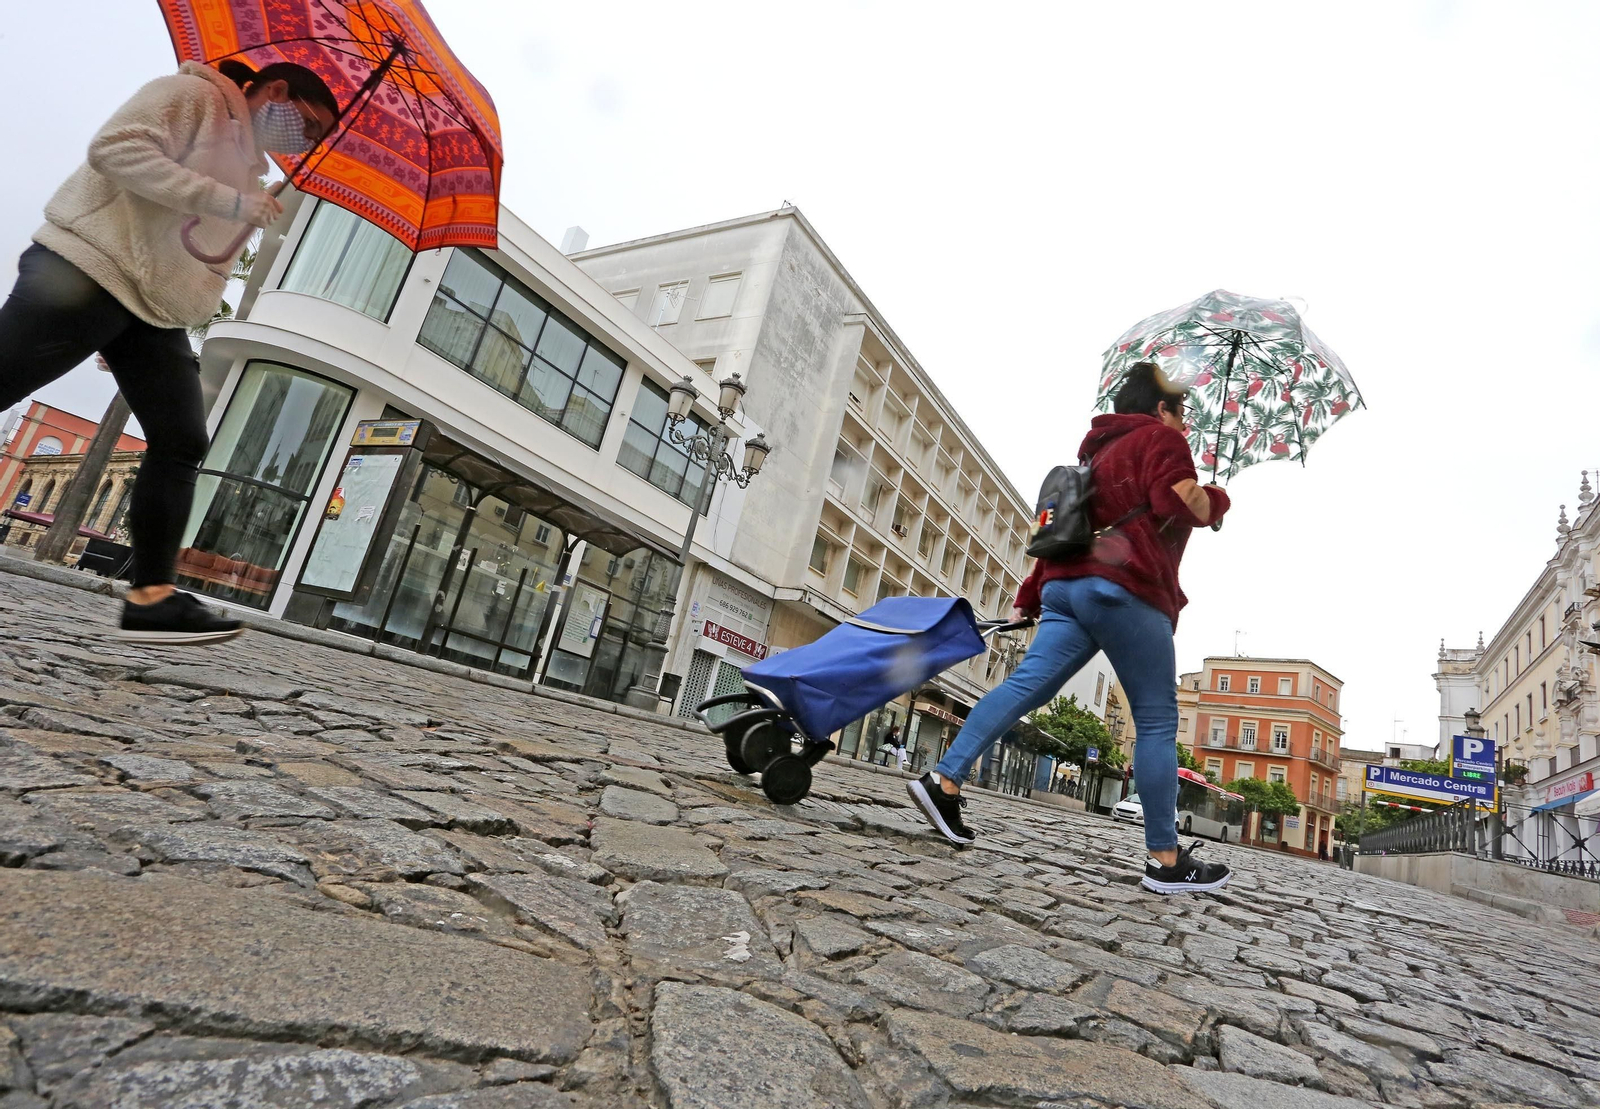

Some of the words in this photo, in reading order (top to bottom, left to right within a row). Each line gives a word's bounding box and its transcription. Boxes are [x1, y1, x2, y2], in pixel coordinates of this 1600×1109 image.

[727, 583, 767, 610] PROFESIONALES
[740, 609, 748, 618] 762
[721, 631, 747, 650] ESTEVE
[747, 642, 752, 652] 4
[1463, 738, 1484, 760] P
[1369, 767, 1381, 780] P
[1390, 771, 1440, 788] Mercado
[1462, 771, 1481, 779] LIBRE
